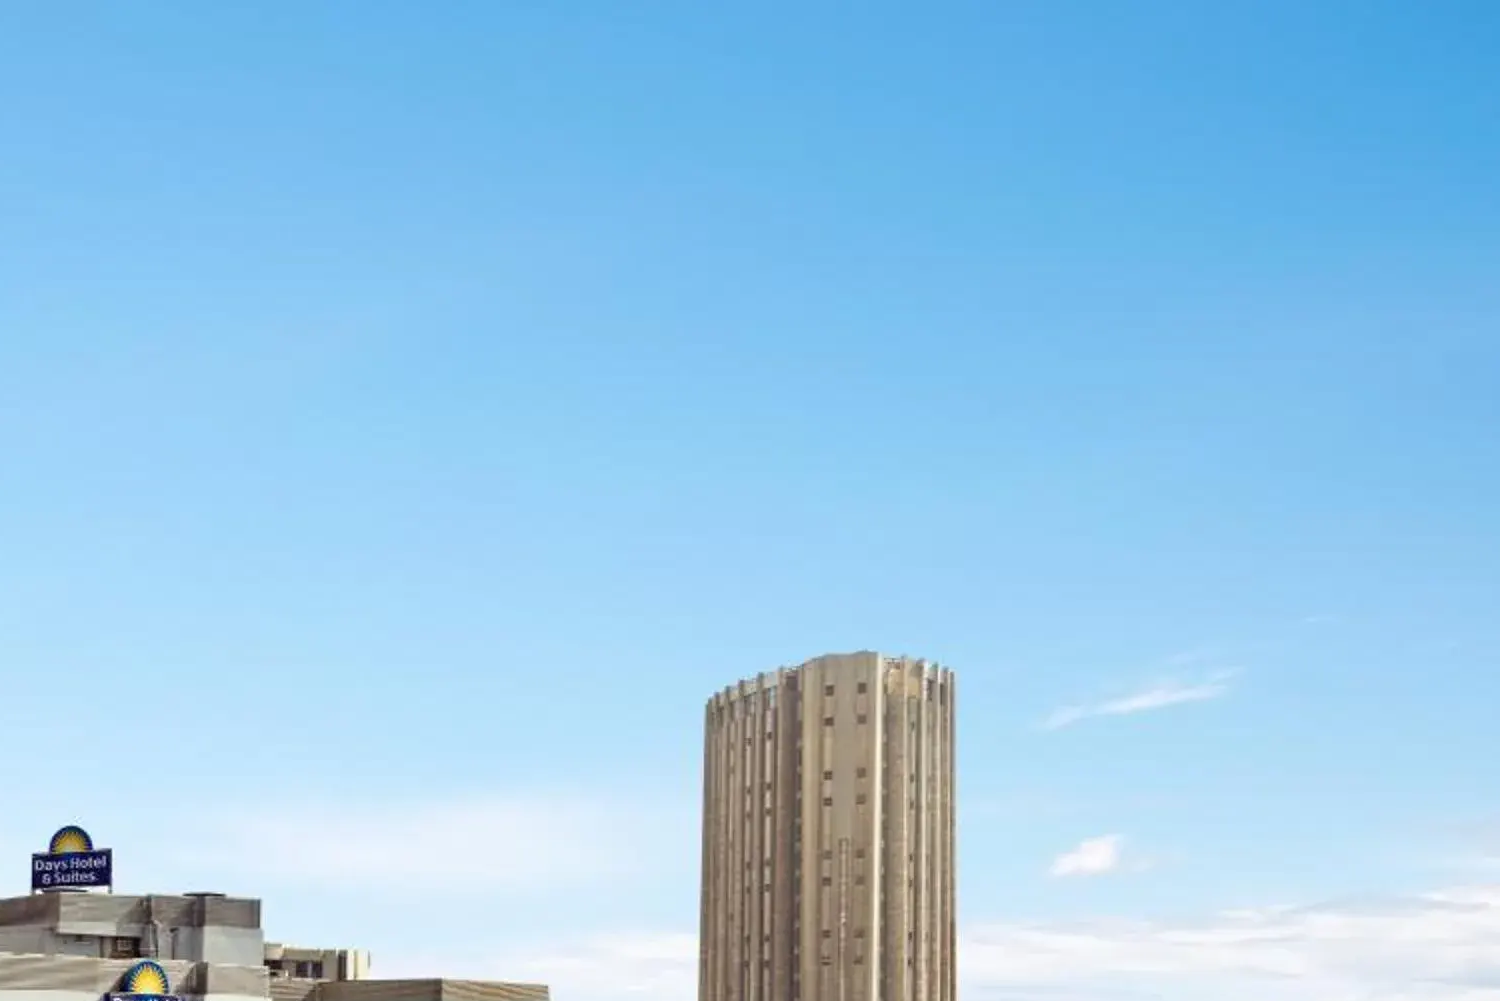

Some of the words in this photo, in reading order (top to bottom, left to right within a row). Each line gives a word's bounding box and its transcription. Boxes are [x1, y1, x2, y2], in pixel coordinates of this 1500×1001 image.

[35, 859, 68, 871] Days
[70, 855, 106, 869] Hotel
[42, 873, 51, 885] &
[53, 871, 96, 883] Suites
